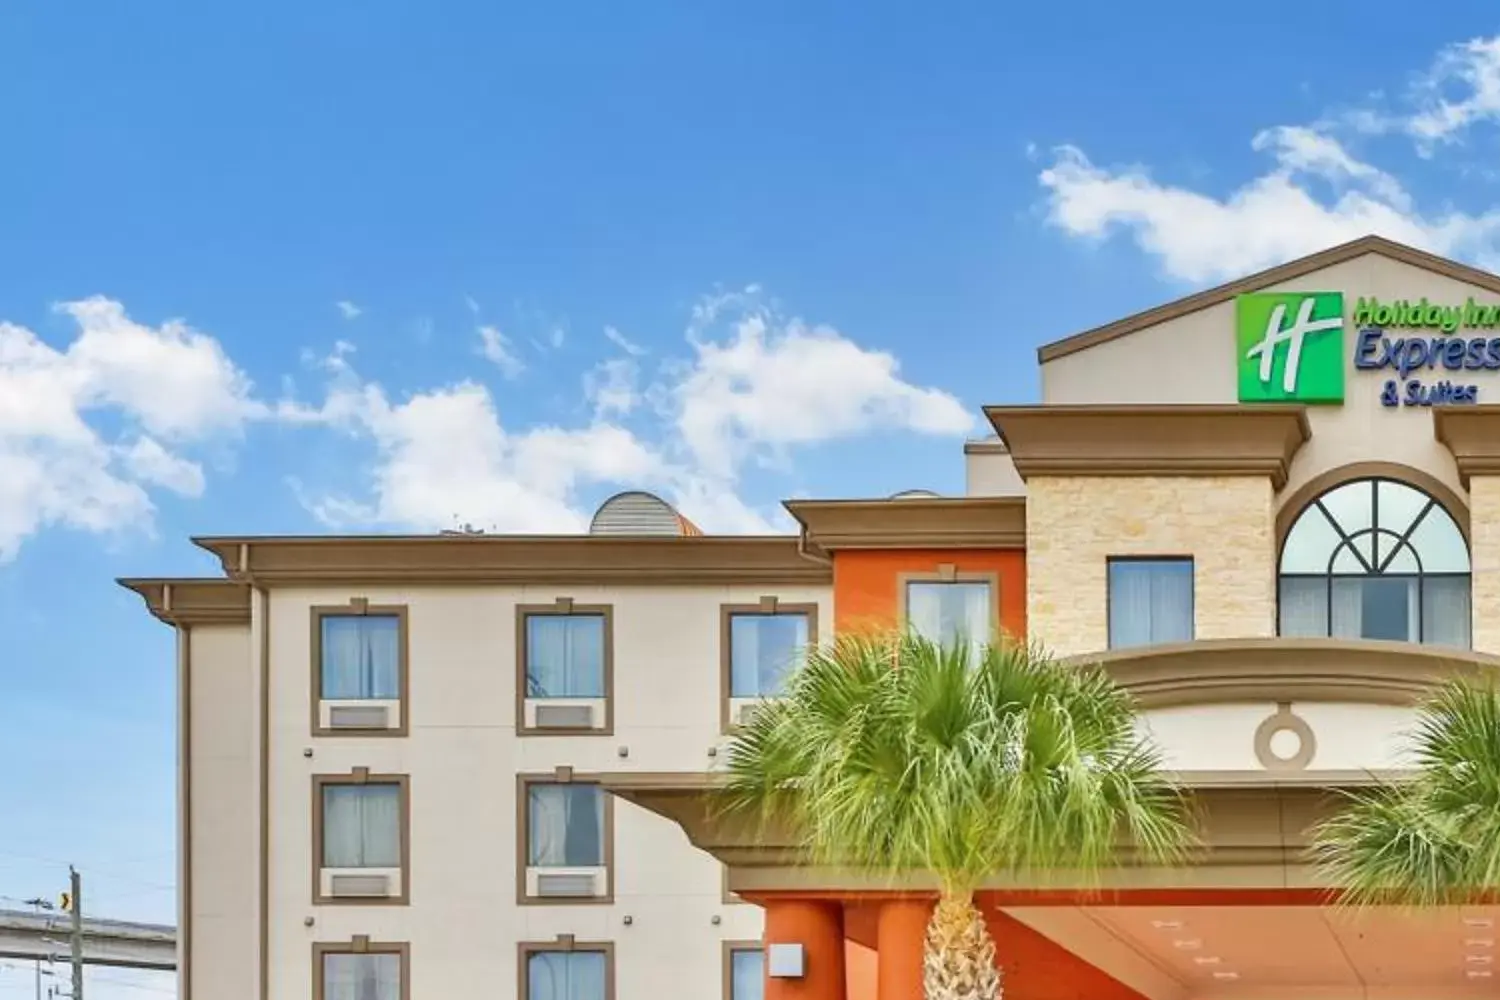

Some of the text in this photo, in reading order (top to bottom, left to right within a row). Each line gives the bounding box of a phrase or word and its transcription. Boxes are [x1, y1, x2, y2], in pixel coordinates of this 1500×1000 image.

[1354, 297, 1460, 333] Holiday
[1381, 380, 1478, 406] & Suites
